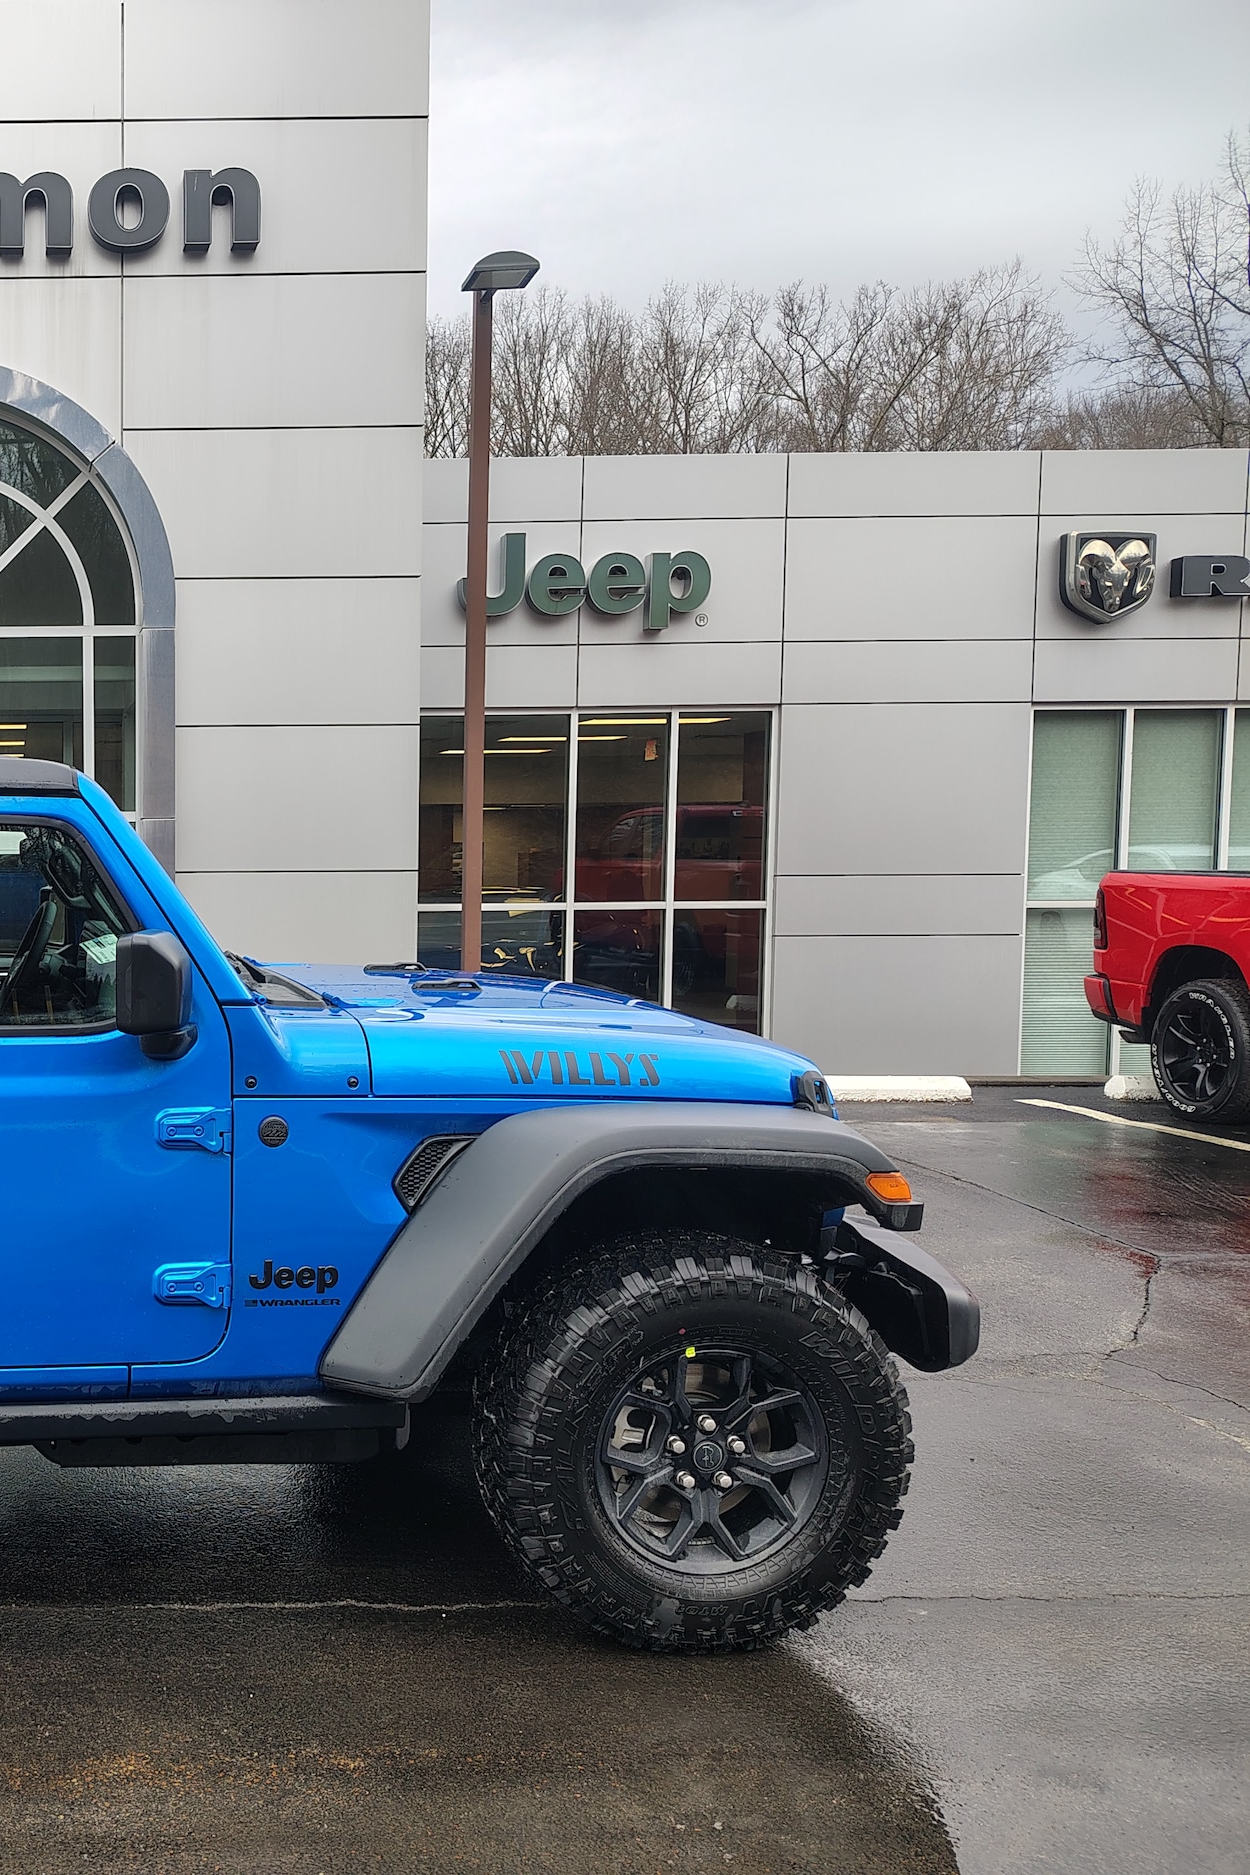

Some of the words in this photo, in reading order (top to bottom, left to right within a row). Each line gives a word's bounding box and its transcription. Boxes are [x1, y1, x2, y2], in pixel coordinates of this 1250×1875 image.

[457, 532, 712, 631] Jeep
[499, 1050, 661, 1087] WILLYS
[249, 1259, 339, 1294] Jeep
[259, 1298, 341, 1308] WRANGLER
